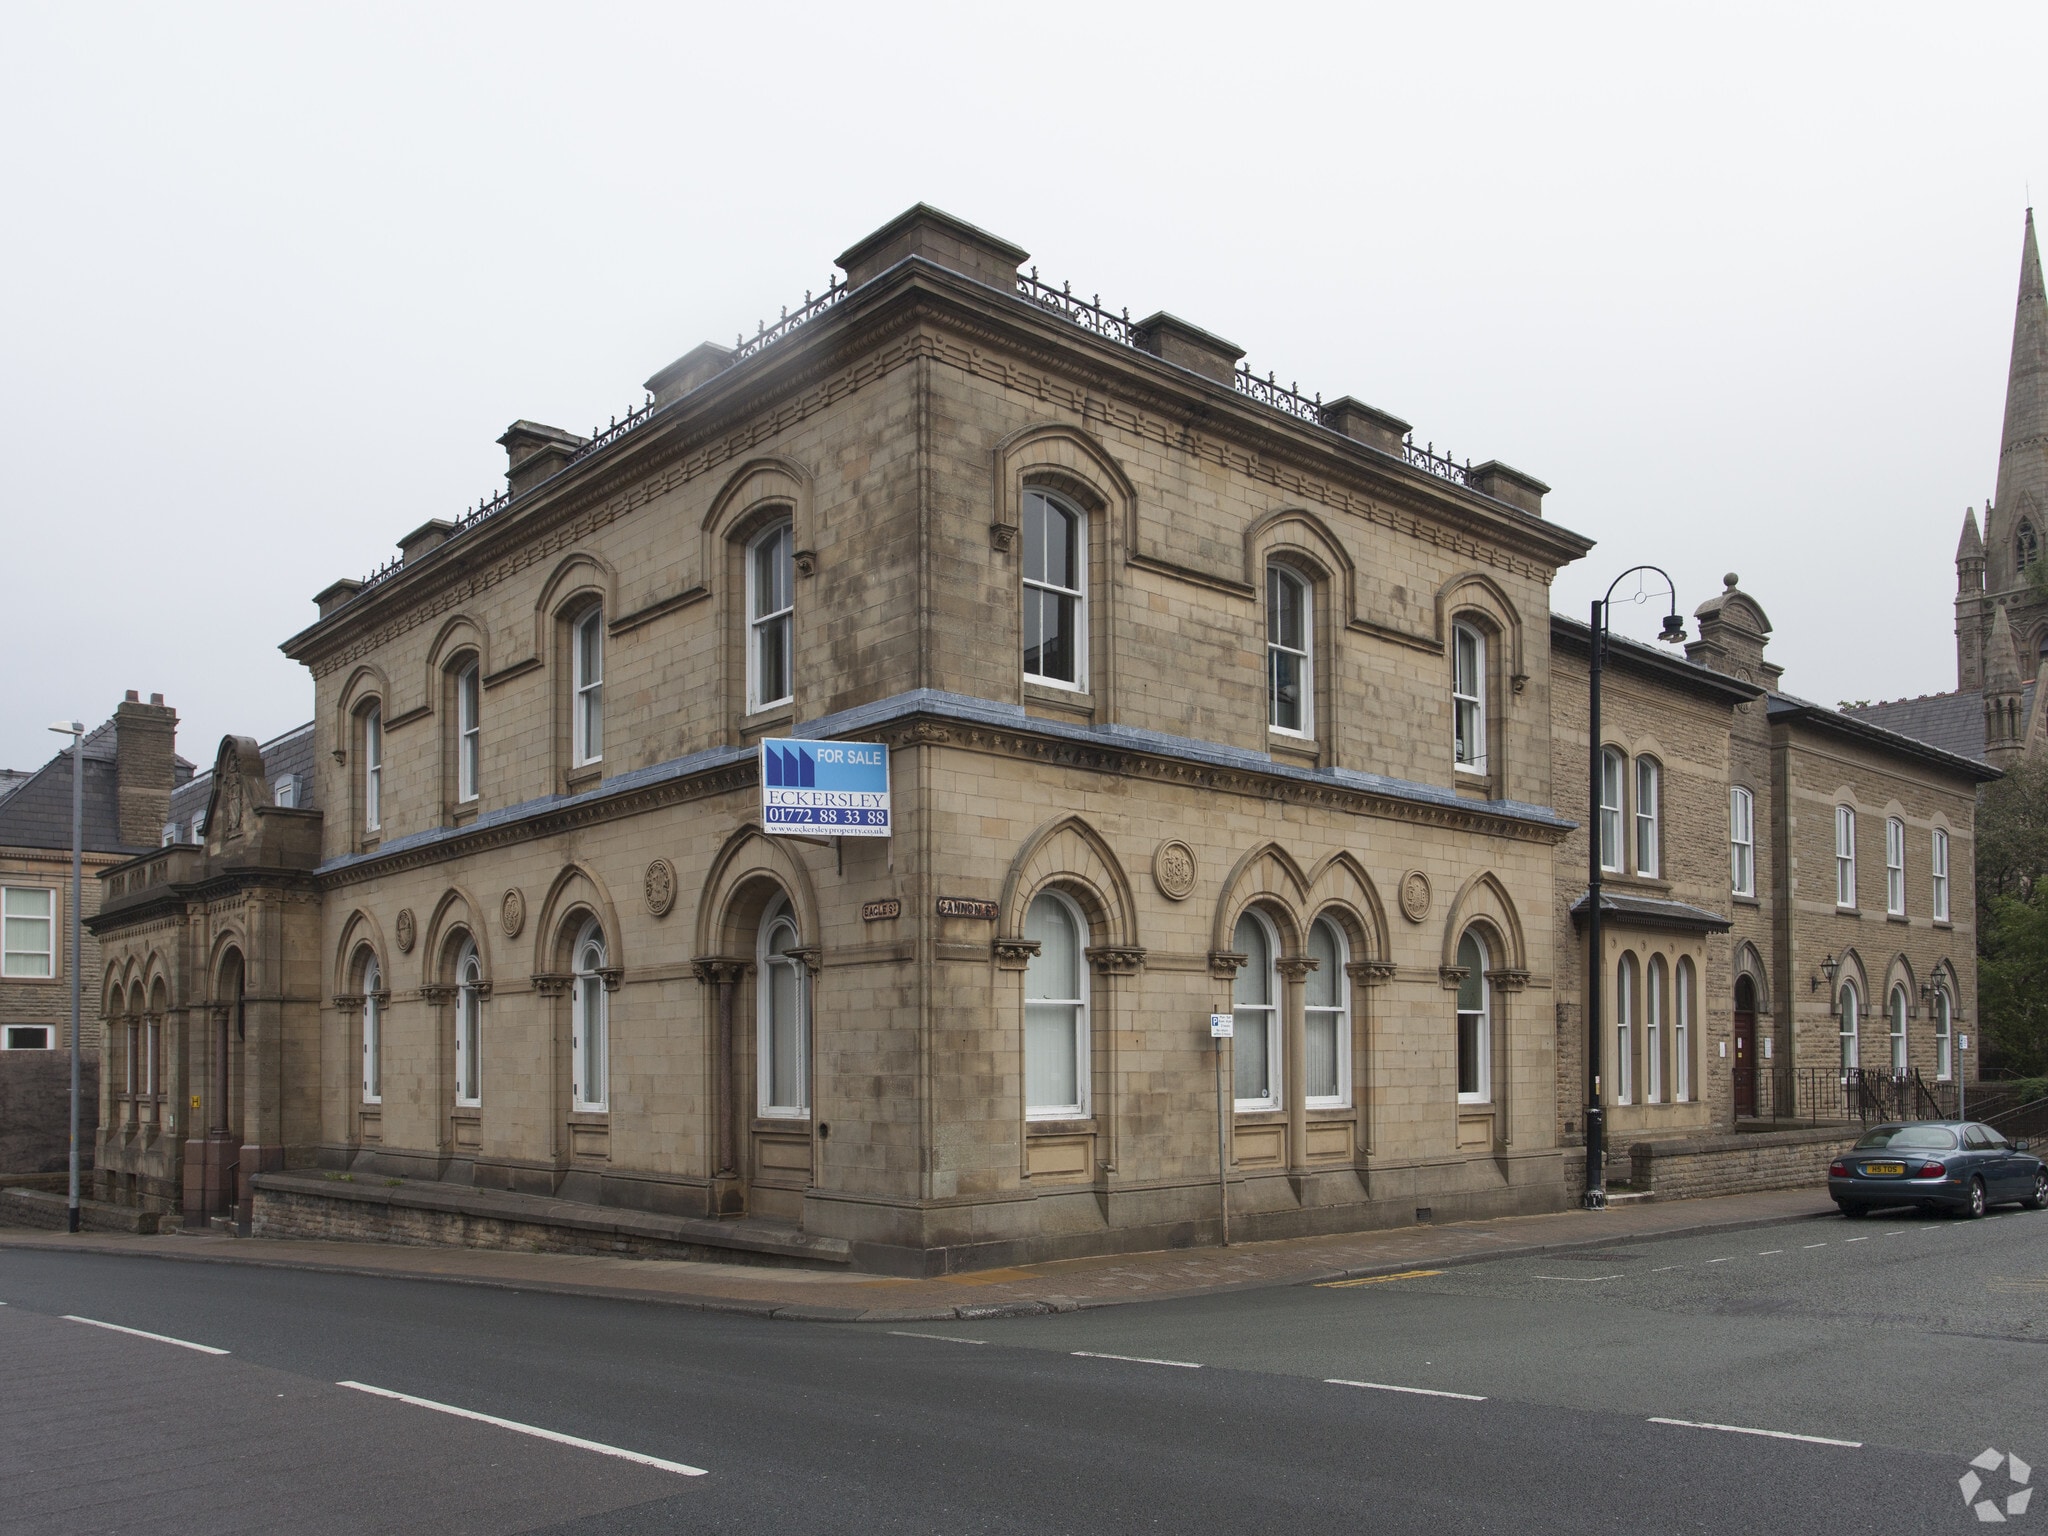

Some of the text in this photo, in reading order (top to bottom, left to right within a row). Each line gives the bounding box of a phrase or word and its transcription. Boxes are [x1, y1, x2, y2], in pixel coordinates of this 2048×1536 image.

[817, 749, 882, 765] FOR SALE
[769, 790, 884, 808] ECKERSLEY
[769, 807, 885, 825] 01772 88 33 88
[770, 826, 884, 836] www.eckersleyproperty.co.uk
[864, 905, 887, 917] EAGLE
[941, 899, 981, 915] CANNON
